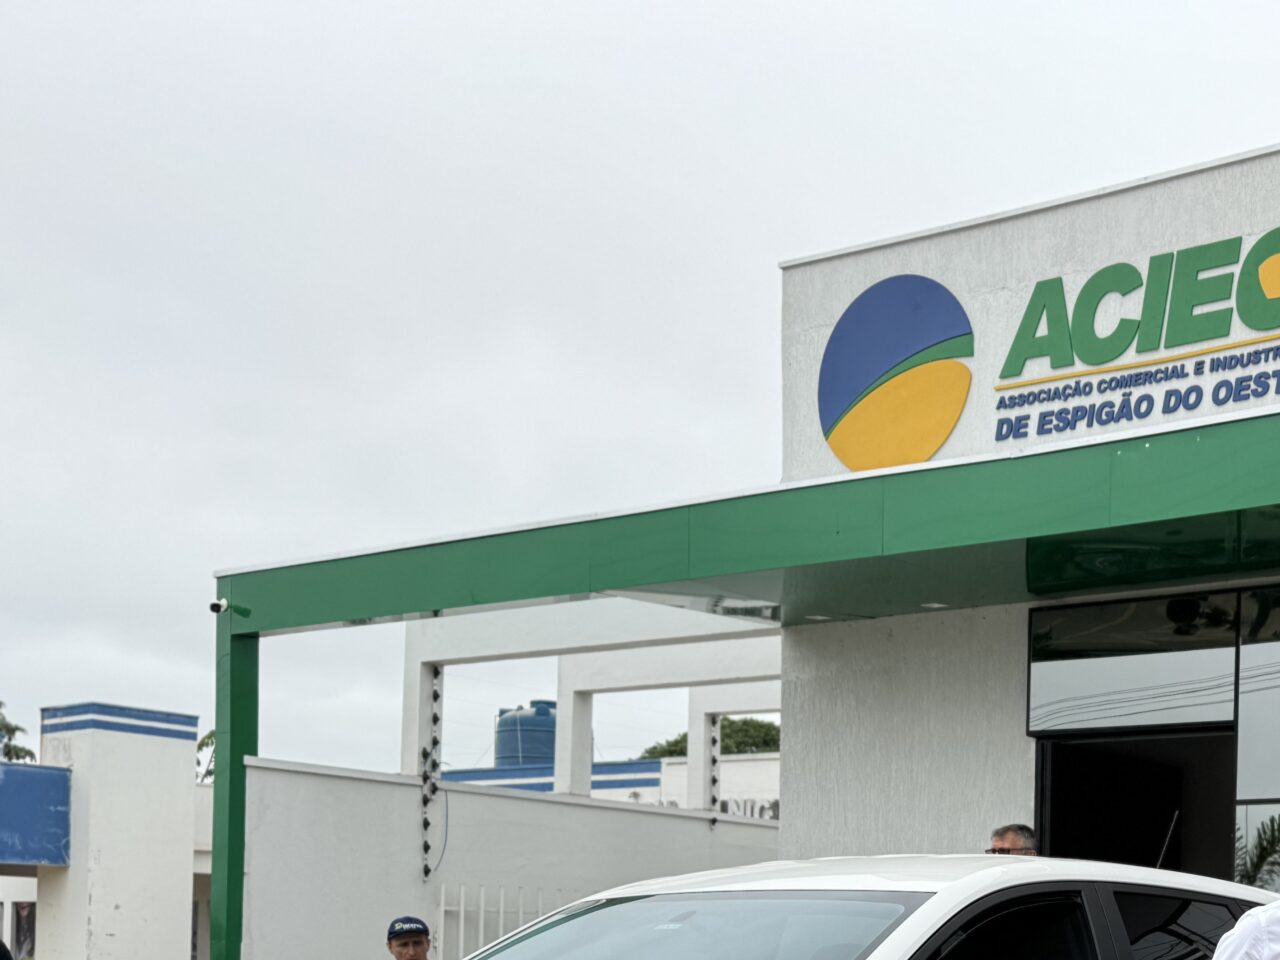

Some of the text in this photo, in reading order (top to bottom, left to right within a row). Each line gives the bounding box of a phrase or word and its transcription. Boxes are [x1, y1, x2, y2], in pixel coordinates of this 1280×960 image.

[996, 380, 1094, 410] ASSOCIAÇÃO
[1097, 364, 1189, 394] COMERCIAL
[1193, 360, 1205, 375] E
[995, 414, 1030, 441] DE
[1036, 391, 1154, 435] ESPIGÃO
[1162, 385, 1203, 414] DO
